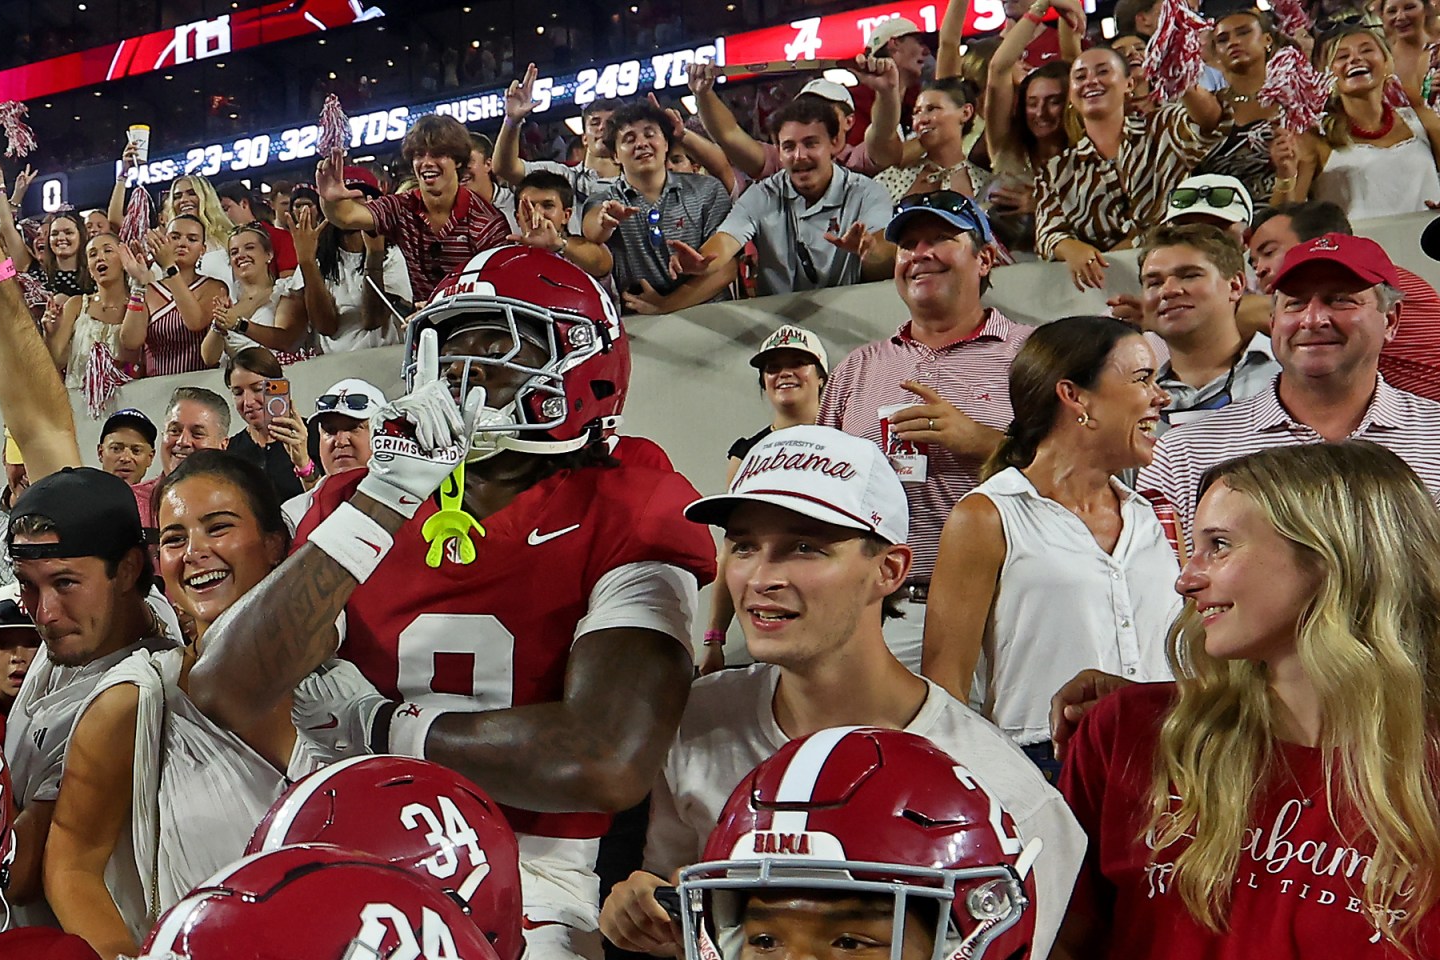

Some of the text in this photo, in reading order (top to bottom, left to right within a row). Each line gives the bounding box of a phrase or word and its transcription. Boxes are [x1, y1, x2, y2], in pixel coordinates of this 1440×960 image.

[277, 124, 325, 162] 32
[348, 107, 410, 149] YDS
[573, 60, 639, 105] 249
[42, 179, 63, 213] 0
[732, 447, 857, 494] Alabama
[400, 795, 482, 880] 34
[752, 832, 810, 856] BAMA
[1279, 876, 1364, 914] TIDE
